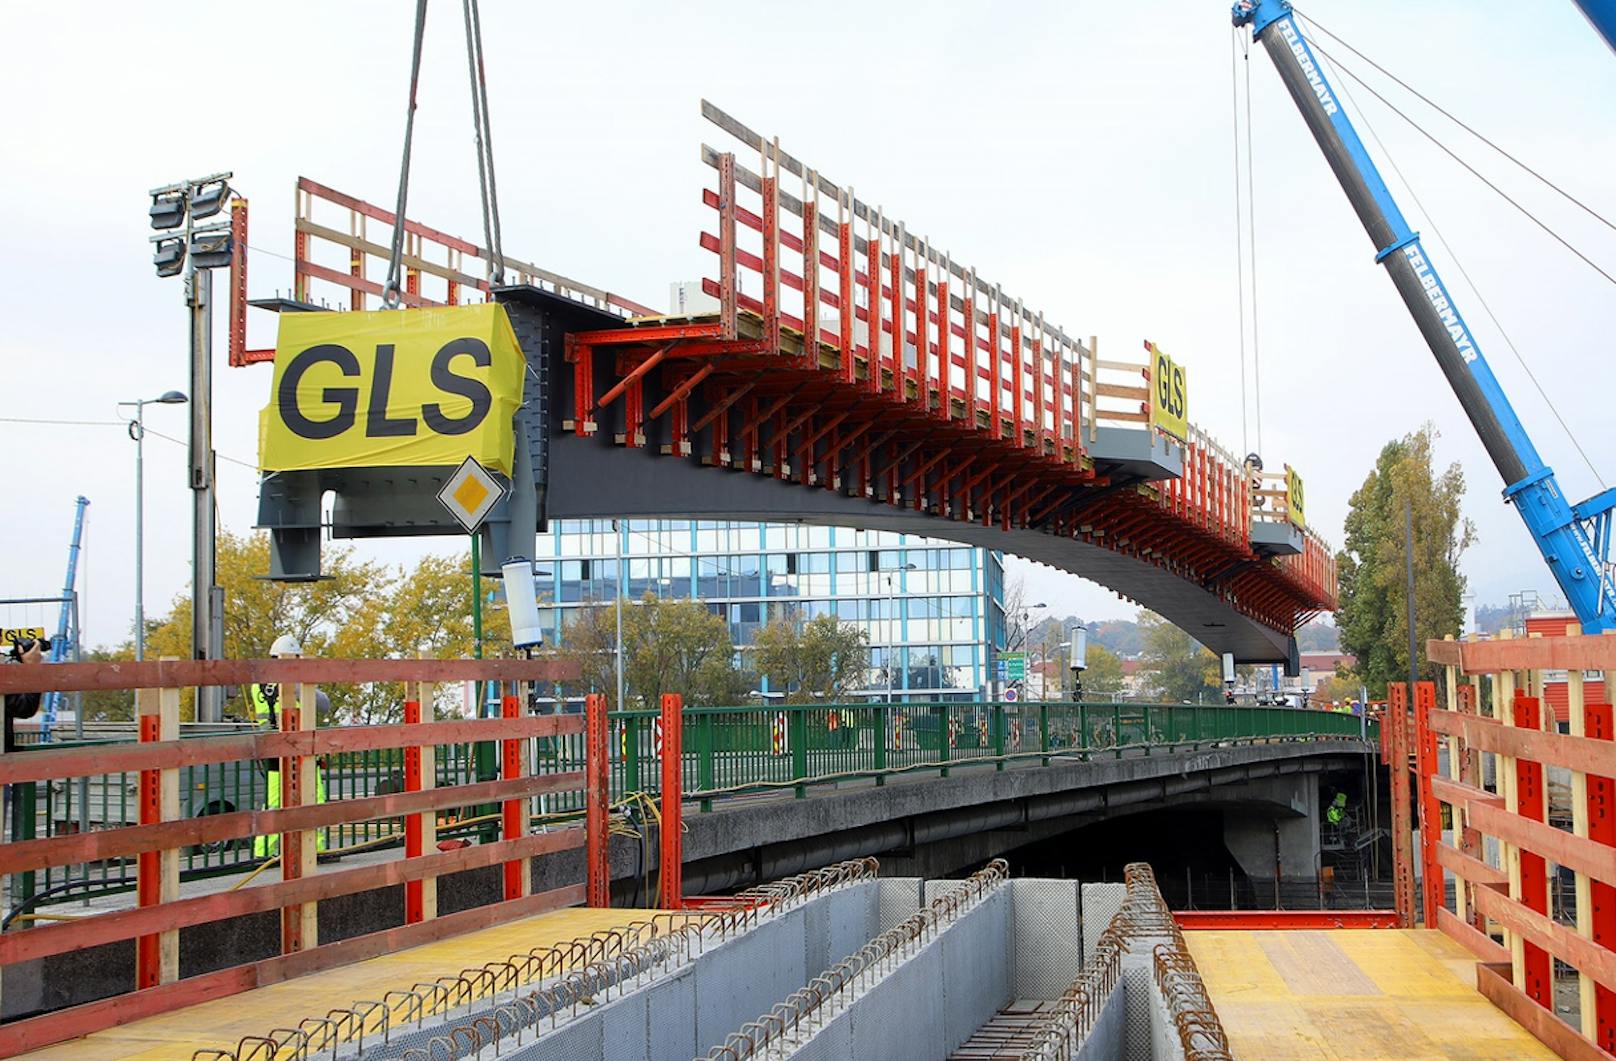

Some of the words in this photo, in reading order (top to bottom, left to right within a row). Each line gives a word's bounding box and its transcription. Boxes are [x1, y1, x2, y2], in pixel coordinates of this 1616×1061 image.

[1278, 19, 1338, 116] FELBERMAYR
[1404, 244, 1478, 365] FELBERMAYR
[278, 337, 493, 440] GLS
[1158, 356, 1183, 420] GLS
